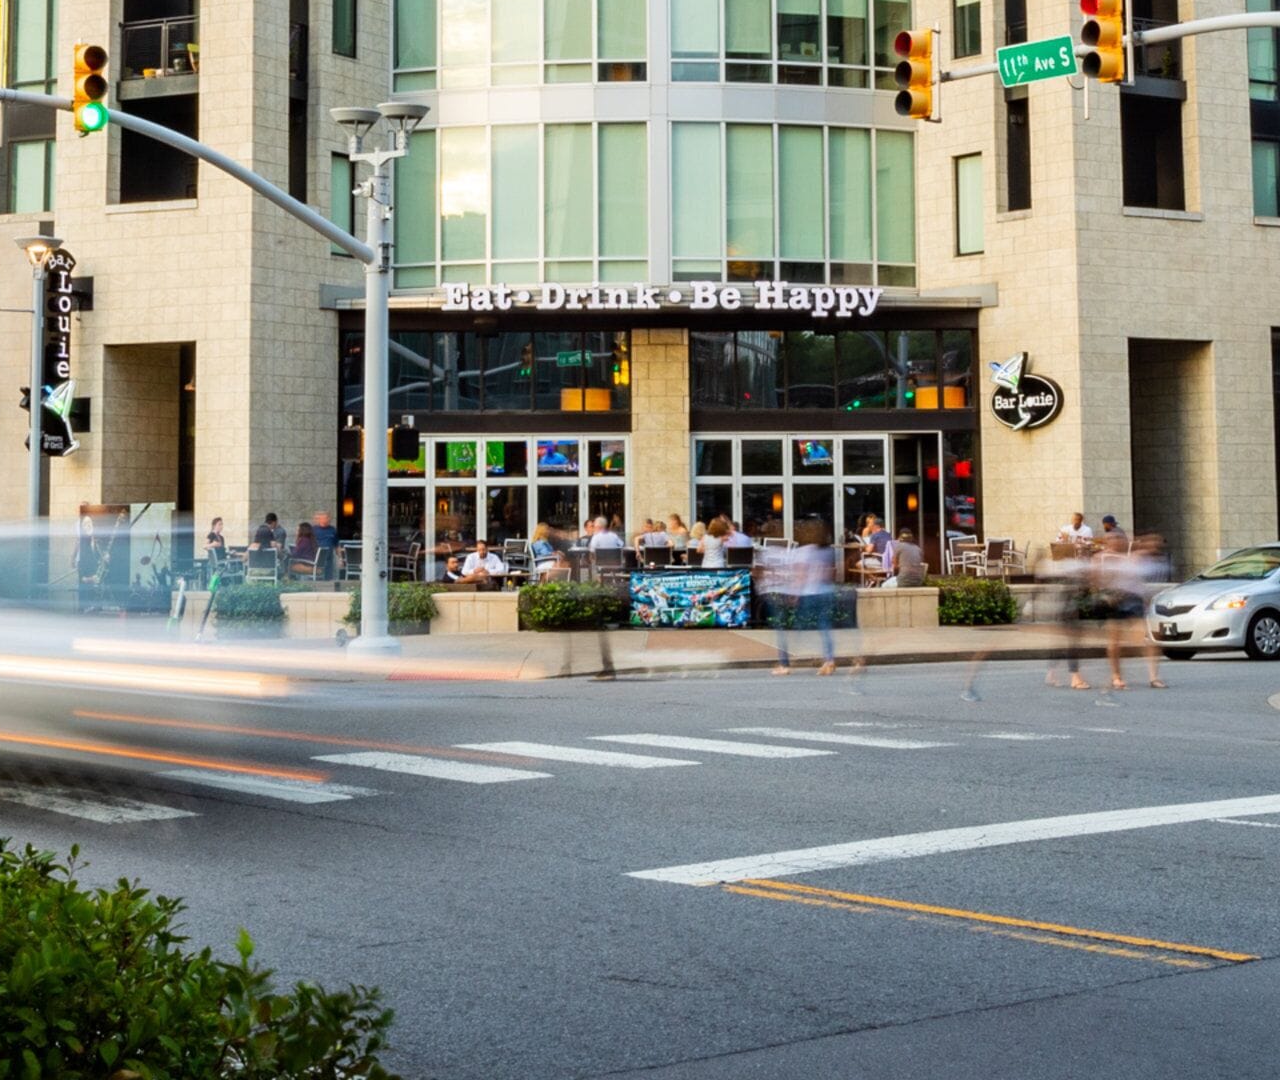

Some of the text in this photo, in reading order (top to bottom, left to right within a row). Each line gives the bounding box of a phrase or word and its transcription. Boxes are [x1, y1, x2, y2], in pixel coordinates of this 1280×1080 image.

[1034, 56, 1056, 72] Ave
[1059, 46, 1070, 67] S
[47, 253, 74, 270] Bar
[440, 280, 884, 317] Eat Drink Be Happy
[57, 271, 73, 378] Louie
[994, 391, 1054, 410] Bar Louie
